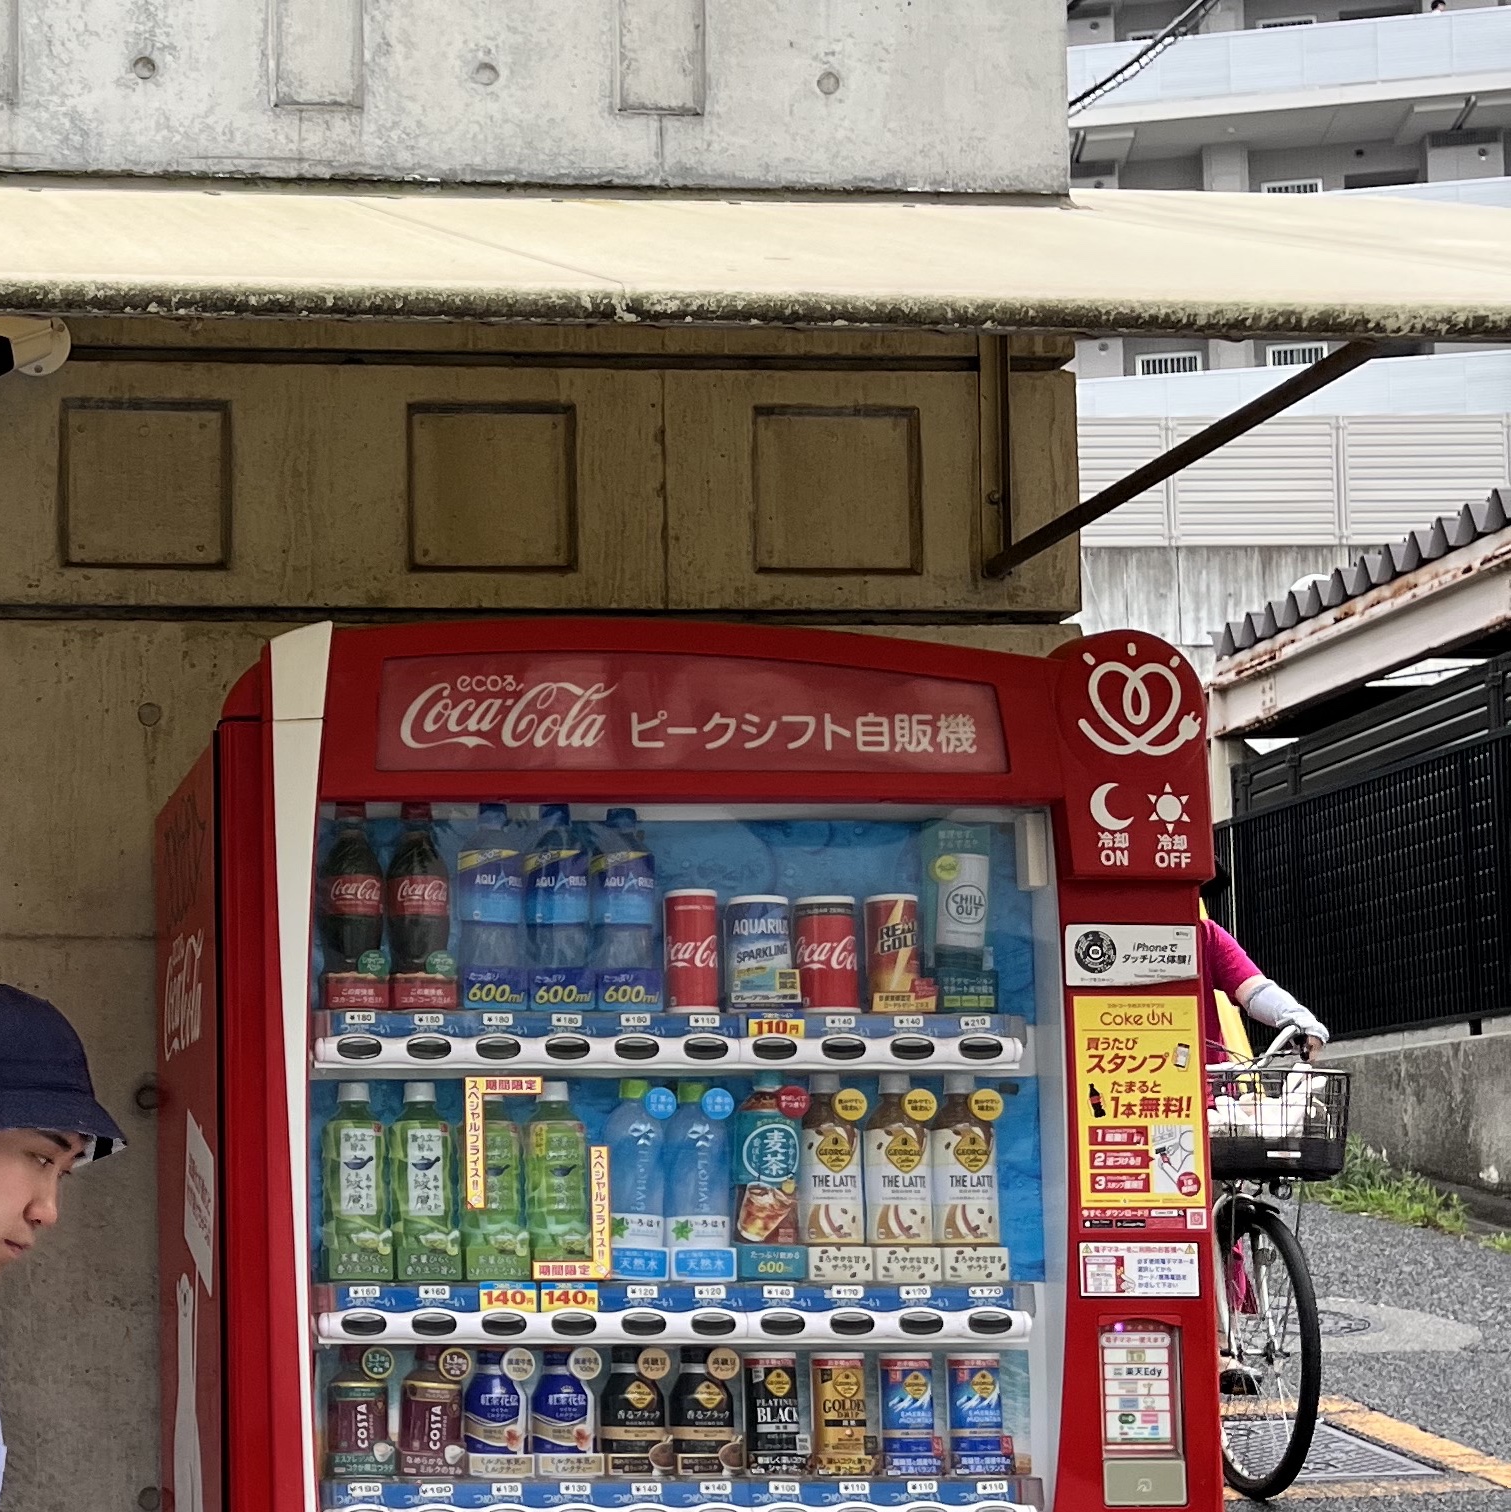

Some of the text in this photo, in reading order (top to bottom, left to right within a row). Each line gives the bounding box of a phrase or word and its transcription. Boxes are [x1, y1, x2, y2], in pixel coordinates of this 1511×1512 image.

[400, 682, 618, 748] Coca-Cola
[630, 712, 977, 755] ピークシフト自販機
[1097, 832, 1130, 850] 冷却
[1157, 834, 1188, 851] 冷却
[1100, 851, 1129, 867] ON
[1155, 852, 1192, 868] OFF
[475, 868, 522, 891] AQUARIUS
[536, 870, 586, 892] AQUARIUS
[604, 872, 654, 893] AQUARIUS
[952, 893, 985, 907] CHILL
[956, 905, 979, 917] OUT
[736, 943, 788, 963] SPARKLING
[1133, 943, 1178, 952] iPhoneで
[468, 983, 524, 1003] 600ml
[535, 984, 592, 1004] 600ml
[604, 984, 660, 1004] 600ml
[486, 1015, 509, 1024] ¥180
[555, 1016, 578, 1025] ¥180
[624, 1015, 647, 1024] ¥180
[963, 1018, 986, 1026] ¥210
[1100, 1009, 1173, 1026] Coke ON
[754, 1020, 799, 1035] 110円
[1086, 1037, 1138, 1051] 買うたび
[1086, 1052, 1169, 1074] スタンプ
[485, 1079, 537, 1091] 期間限定
[1110, 1081, 1161, 1094] たまると
[1111, 1096, 1192, 1119] 1本無料!
[1096, 1129, 1103, 1142] 1
[762, 1129, 787, 1175] 麦茶
[1094, 1153, 1105, 1166] 2
[813, 1175, 857, 1188] THE LATTE
[882, 1175, 926, 1188] THE LATTE
[950, 1175, 993, 1188] THE LATTE
[1095, 1176, 1106, 1189] 3
[538, 1264, 590, 1276] 期間限定
[619, 1257, 658, 1271] 天然水
[687, 1258, 725, 1271] 天然水
[483, 1290, 534, 1306] 140円
[544, 1290, 596, 1306] 140円
[630, 1287, 655, 1296] ¥120
[697, 1287, 722, 1296] ¥120
[767, 1288, 790, 1296] ¥140
[617, 1409, 660, 1420] 香るブラック
[686, 1409, 729, 1420] 香るブラック
[356, 1403, 369, 1448] COSTA
[429, 1405, 442, 1450] COSTA
[496, 1485, 519, 1493] ¥130
[565, 1484, 587, 1492] ¥130
[635, 1485, 657, 1493] ¥140
